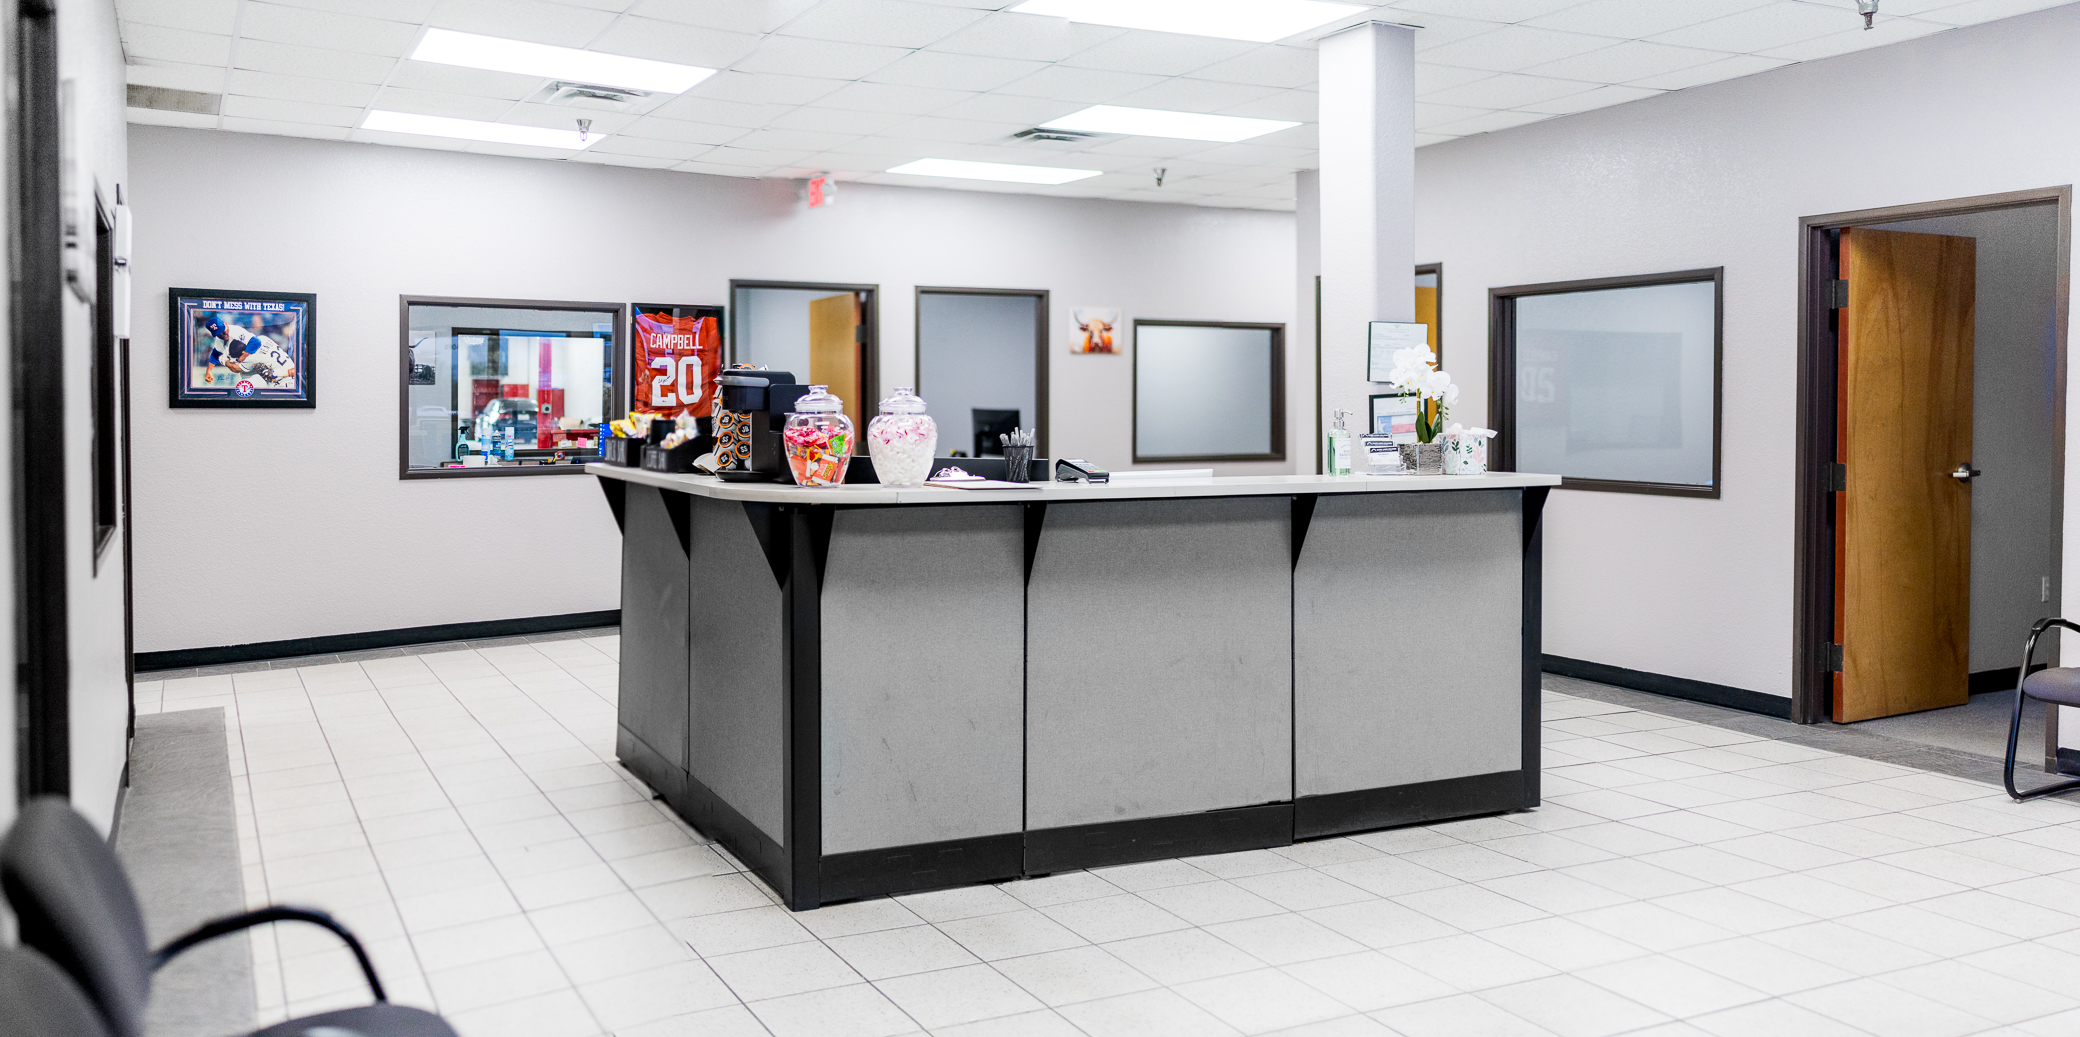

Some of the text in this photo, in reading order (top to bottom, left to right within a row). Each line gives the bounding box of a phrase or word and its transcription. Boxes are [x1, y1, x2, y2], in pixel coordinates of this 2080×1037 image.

[203, 300, 285, 311] DON'T MESS WITH TEXAS!
[650, 333, 703, 349] CAMPBELL
[651, 356, 702, 406] 20
